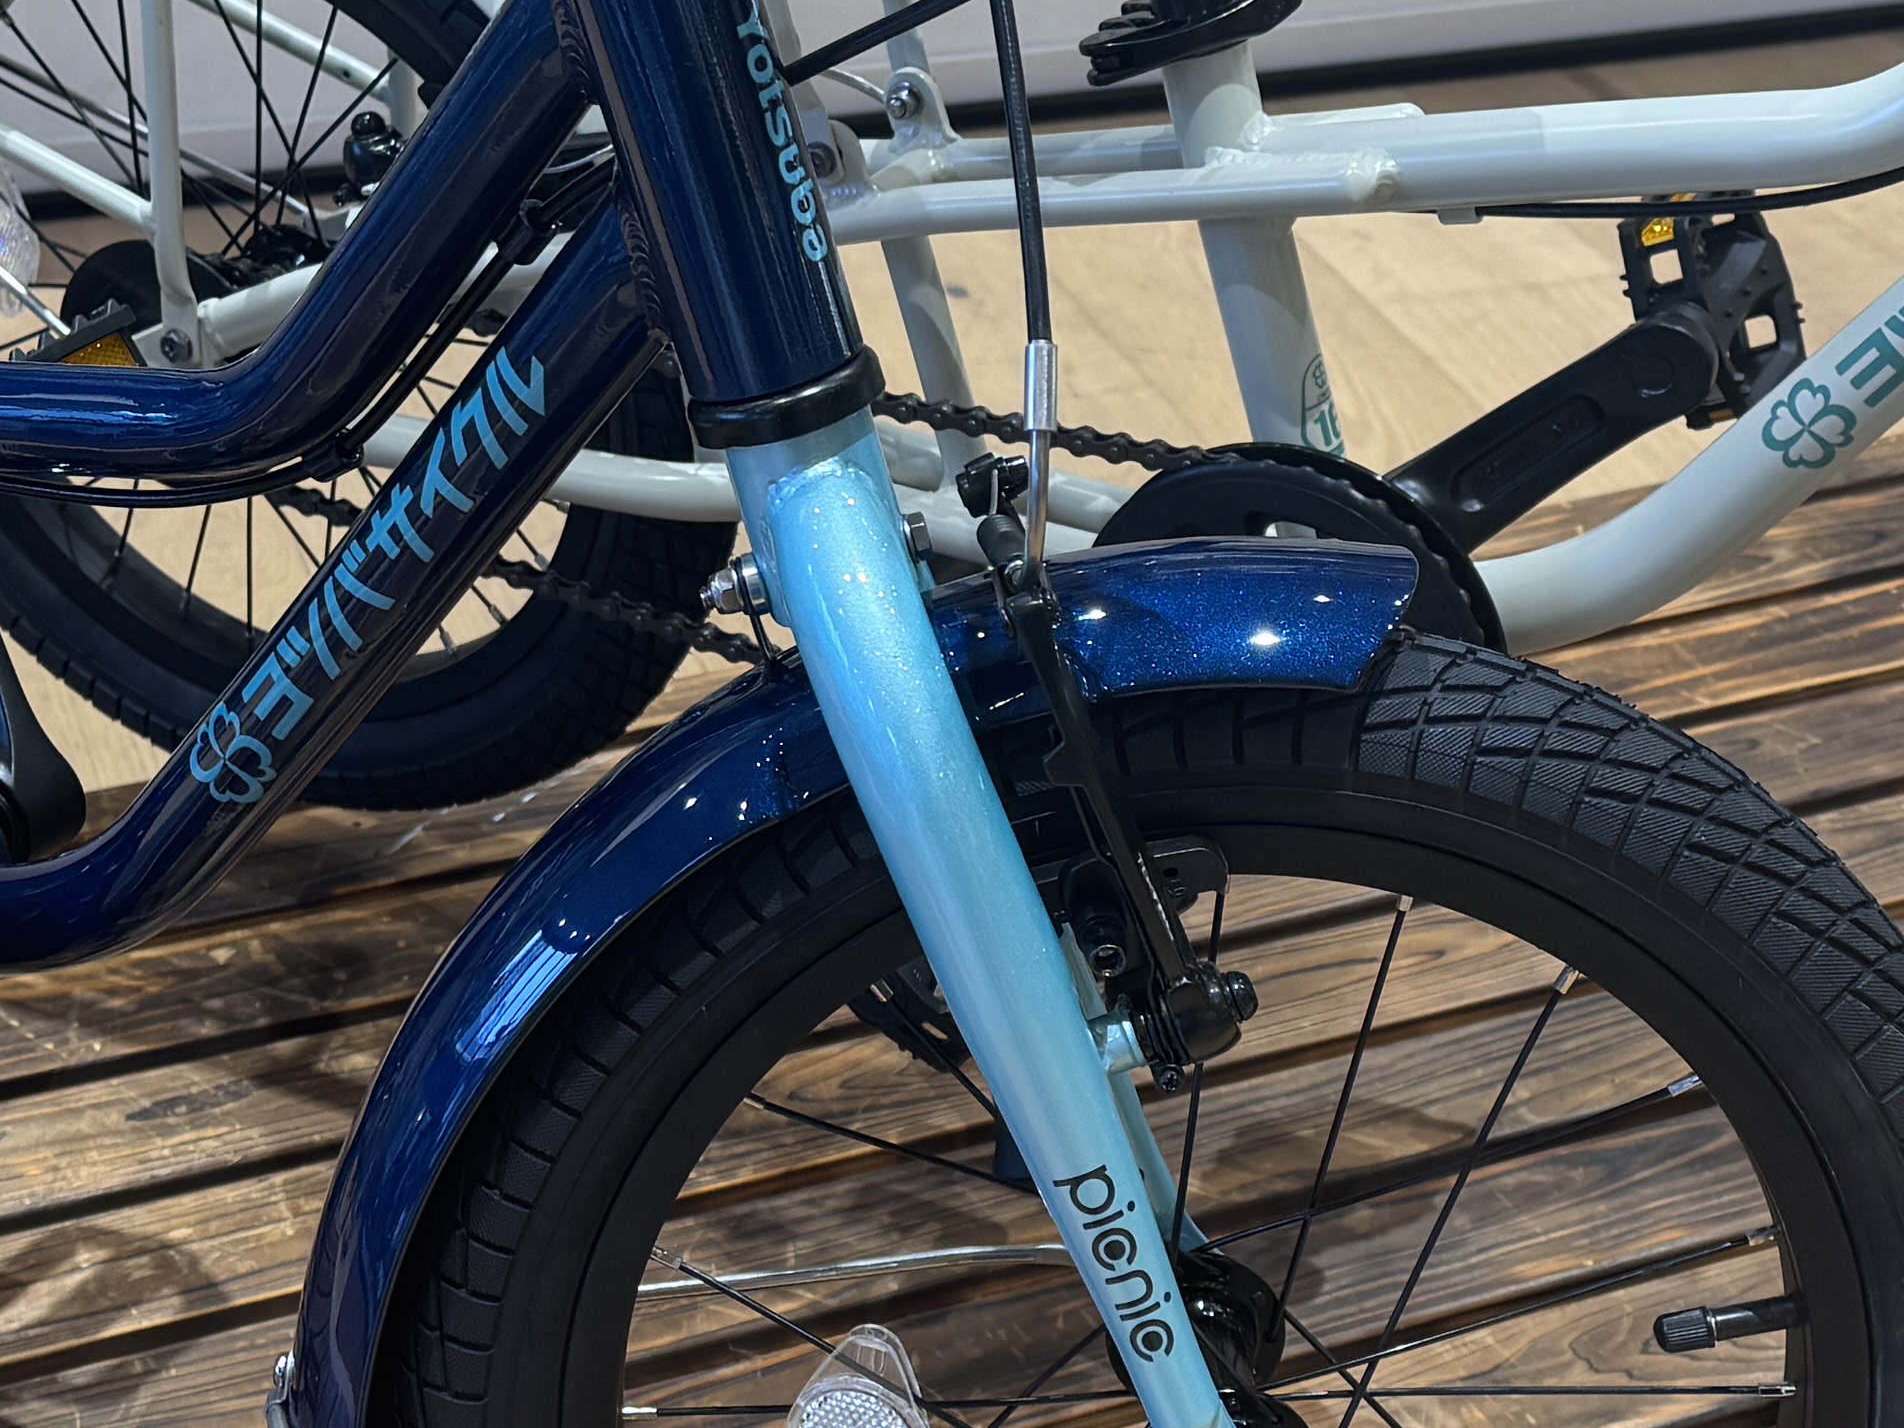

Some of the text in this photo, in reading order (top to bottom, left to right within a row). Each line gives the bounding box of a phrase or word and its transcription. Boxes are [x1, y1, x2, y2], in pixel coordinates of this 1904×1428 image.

[241, 346, 546, 742] ヨツバサイクル
[1053, 1164, 1175, 1363] picnic
